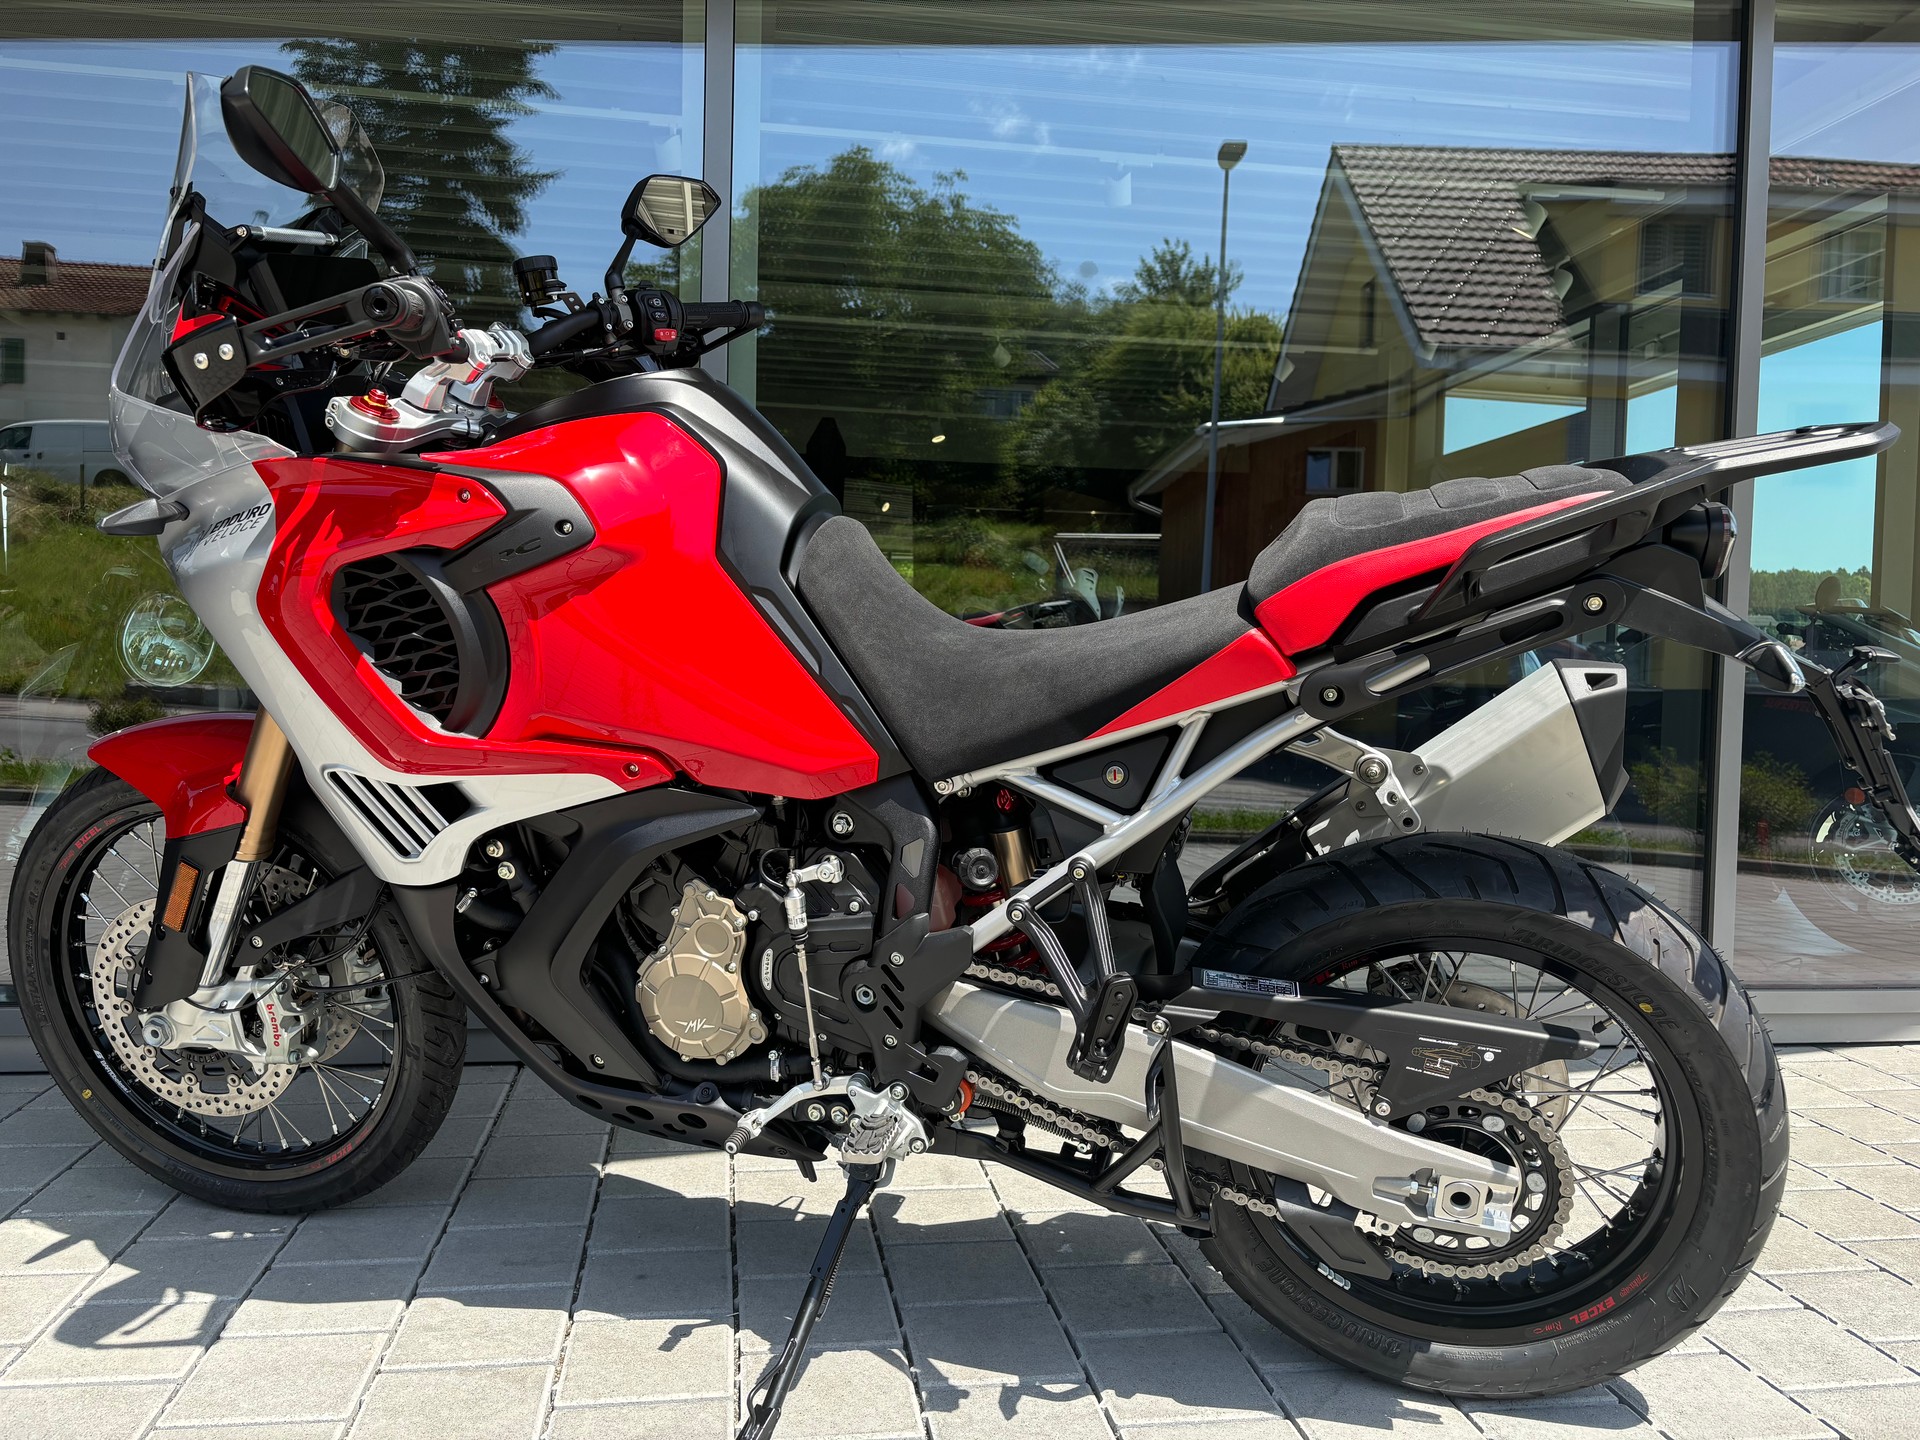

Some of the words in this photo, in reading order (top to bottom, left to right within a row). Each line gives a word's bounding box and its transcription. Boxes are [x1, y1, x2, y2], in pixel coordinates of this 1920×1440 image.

[204, 517, 264, 546] VELOCE
[210, 503, 272, 534] ENDURO
[74, 826, 101, 849] EXCEL
[1511, 926, 1680, 1031] BRIDGESTONE
[266, 1003, 281, 1047] brembo
[683, 1018, 707, 1033] MV
[325, 1142, 353, 1165] EXCEL
[1255, 1256, 1402, 1359] BRIDGESTONE
[1569, 1296, 1616, 1325] EXCEL
[1544, 1320, 1563, 1332] Rim
